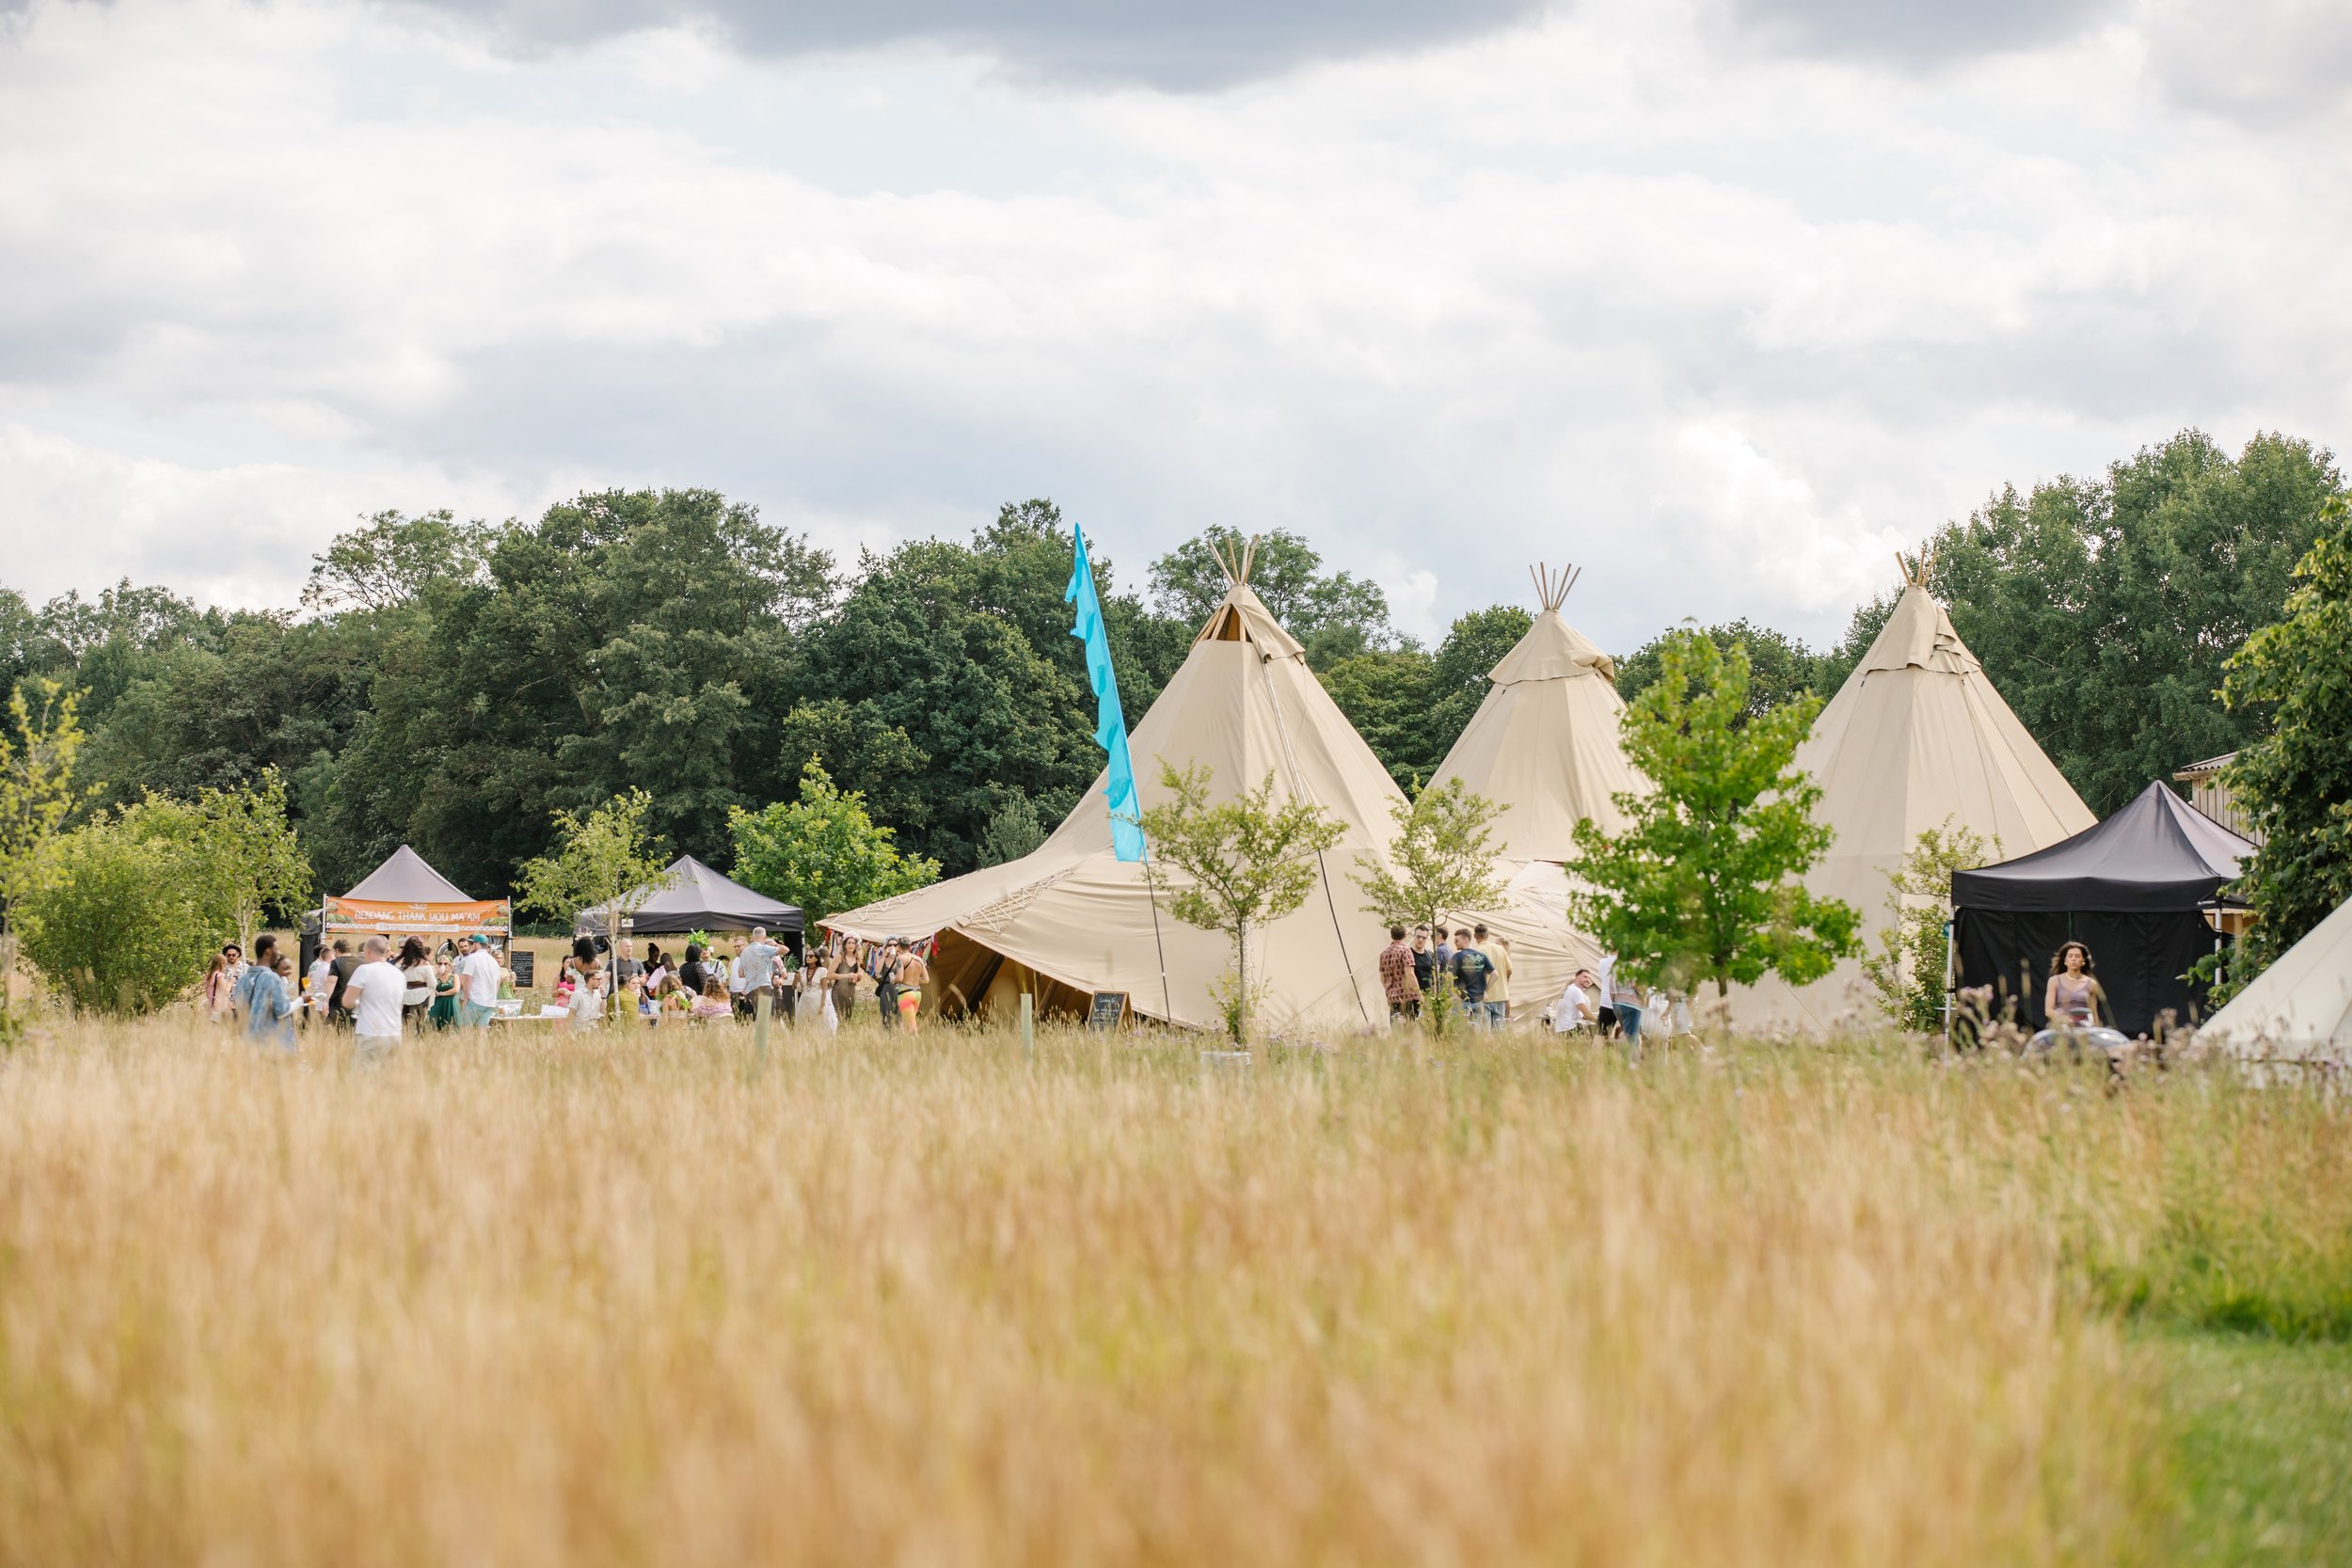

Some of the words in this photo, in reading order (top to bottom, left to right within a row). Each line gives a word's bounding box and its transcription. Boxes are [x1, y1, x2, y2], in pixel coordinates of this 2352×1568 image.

[355, 911, 394, 920] RENDANG
[397, 911, 425, 921] THANK
[429, 912, 449, 922] YOU
